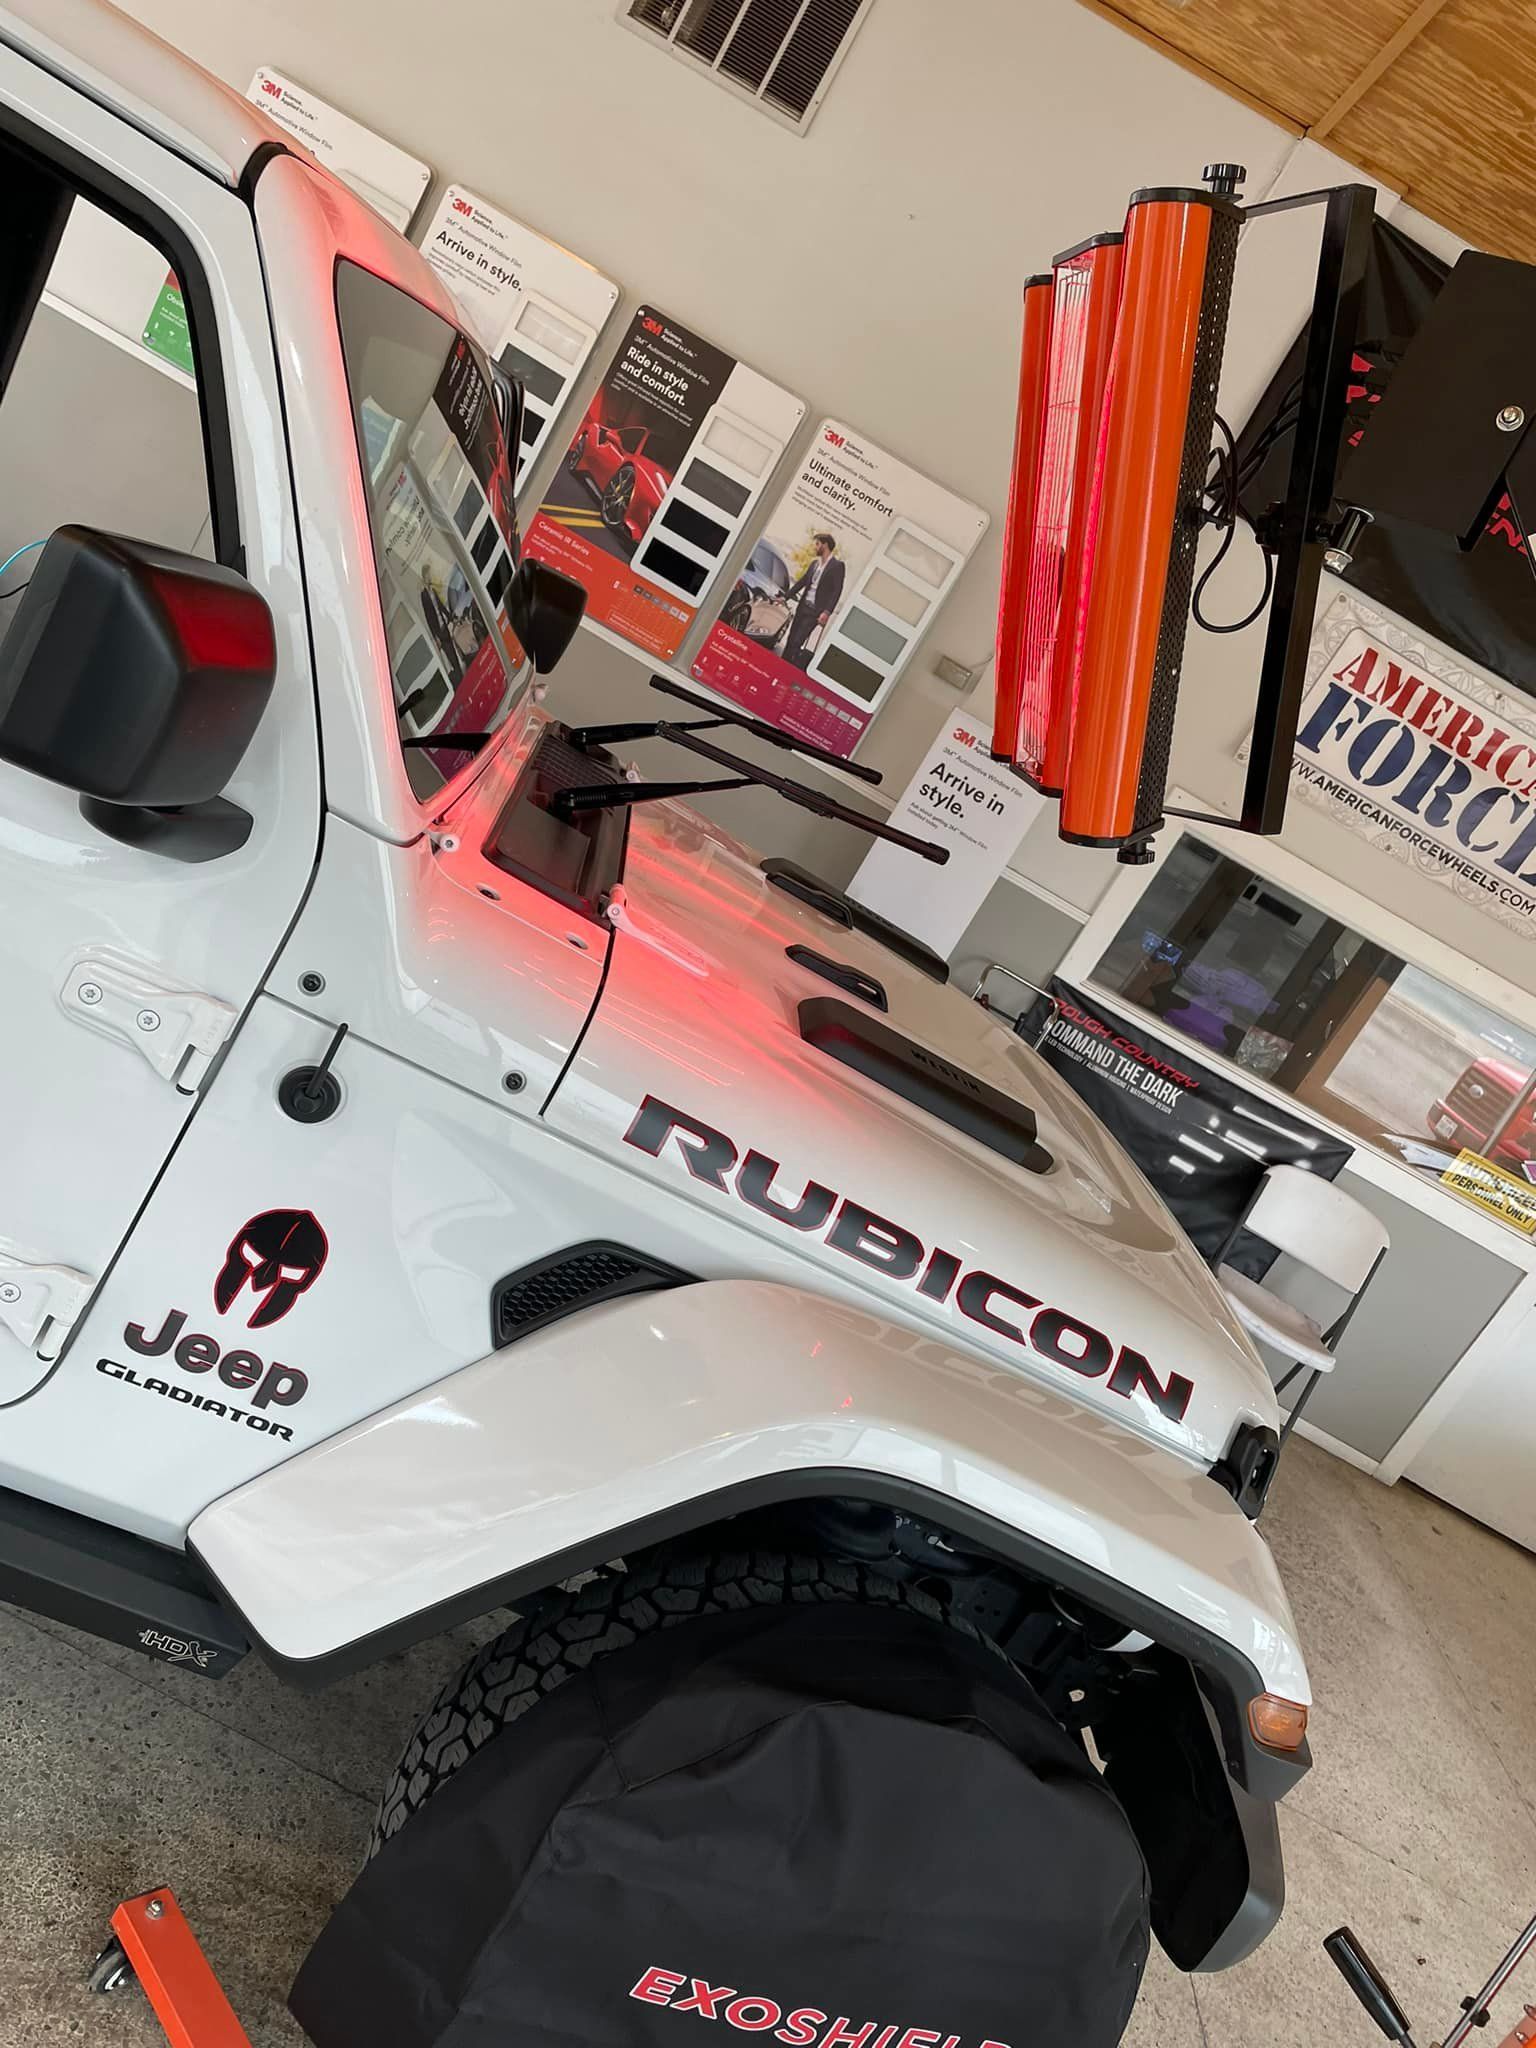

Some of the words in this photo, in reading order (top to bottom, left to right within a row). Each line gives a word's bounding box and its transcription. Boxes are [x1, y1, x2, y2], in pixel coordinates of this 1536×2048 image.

[262, 80, 282, 99] 3M
[452, 199, 473, 216] 3M
[436, 231, 474, 260] Arrive
[477, 254, 488, 269] in
[490, 265, 522, 292] style.
[642, 317, 663, 336] 3M
[621, 361, 643, 377] and
[642, 375, 684, 405] comfort.
[627, 347, 651, 367] Ride
[652, 362, 662, 375] in
[663, 372, 688, 391] style
[825, 430, 845, 448] 3M
[802, 473, 823, 488] and
[823, 486, 855, 510] clarity.
[810, 459, 851, 491] Ultimate
[853, 489, 892, 517] comfort
[953, 728, 976, 747] 3M
[930, 763, 984, 802] Arrive
[987, 794, 1004, 815] in
[956, 756, 987, 776] Automotive
[988, 774, 1010, 790] Window
[1011, 787, 1022, 797] Film
[920, 784, 963, 818] style.
[1112, 1036, 1200, 1088] COUNTRY
[1115, 1056, 1144, 1084] THE
[1140, 1072, 1183, 1107] DARK
[1506, 1204, 1533, 1224] ONLY
[622, 1093, 1194, 1424] RUBICON
[123, 1308, 309, 1410] Jeep
[96, 1357, 294, 1442] GLADIATOR
[144, 1629, 218, 1668] HDX
